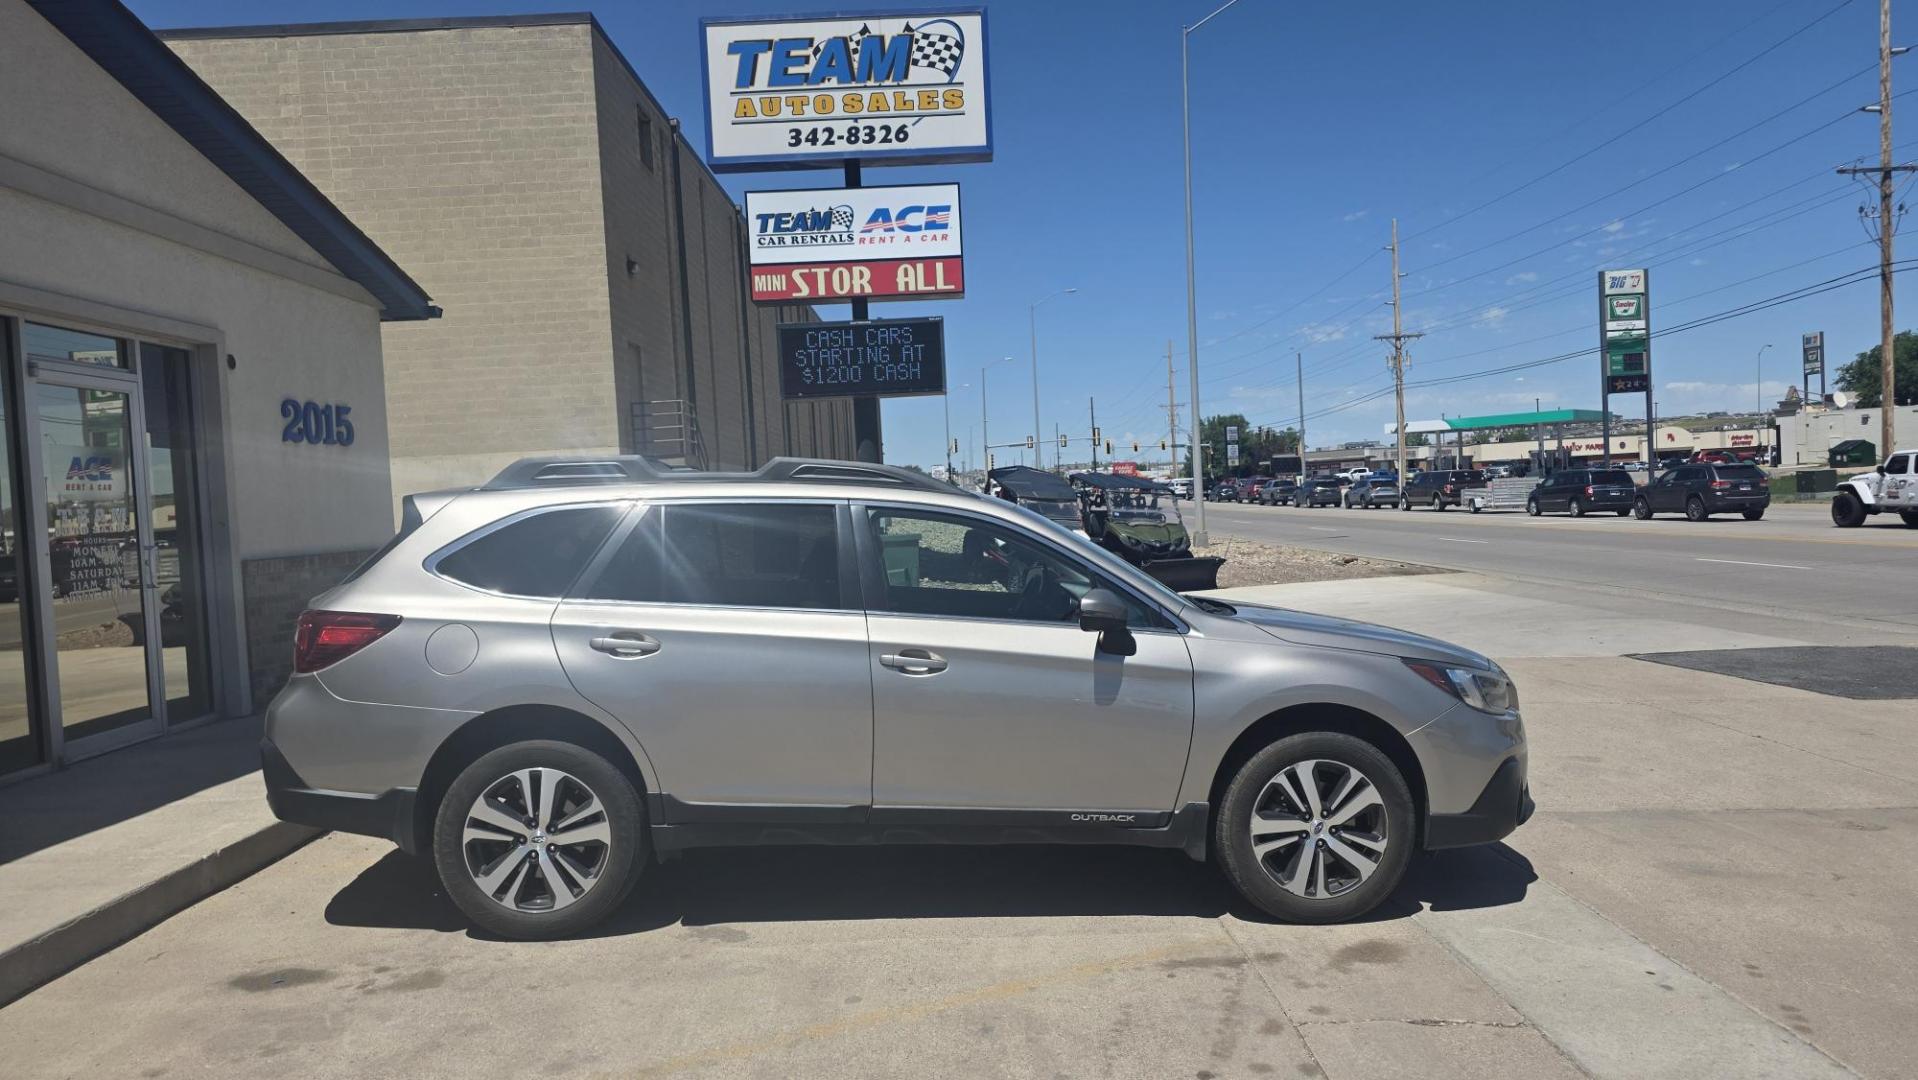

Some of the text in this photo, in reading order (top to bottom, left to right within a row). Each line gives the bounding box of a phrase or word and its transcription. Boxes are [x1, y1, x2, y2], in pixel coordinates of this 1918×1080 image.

[727, 32, 915, 89] TEAM
[787, 123, 910, 148] 342-8326
[755, 209, 834, 234] TEAM
[859, 204, 952, 234] ACE
[757, 233, 855, 246] CAR RENTALS
[858, 233, 949, 245] RENT A CAR
[754, 262, 955, 298] MINI STOR ALL
[1609, 275, 1627, 289] BIG
[805, 327, 913, 348] CASH CARS
[795, 344, 925, 368] STARTING AT
[801, 362, 921, 384] $1200 CASH
[280, 398, 355, 447] 2015
[66, 456, 113, 481] ACE
[70, 567, 124, 580] SATURDAY
[1071, 813, 1136, 822] OUTBACK
